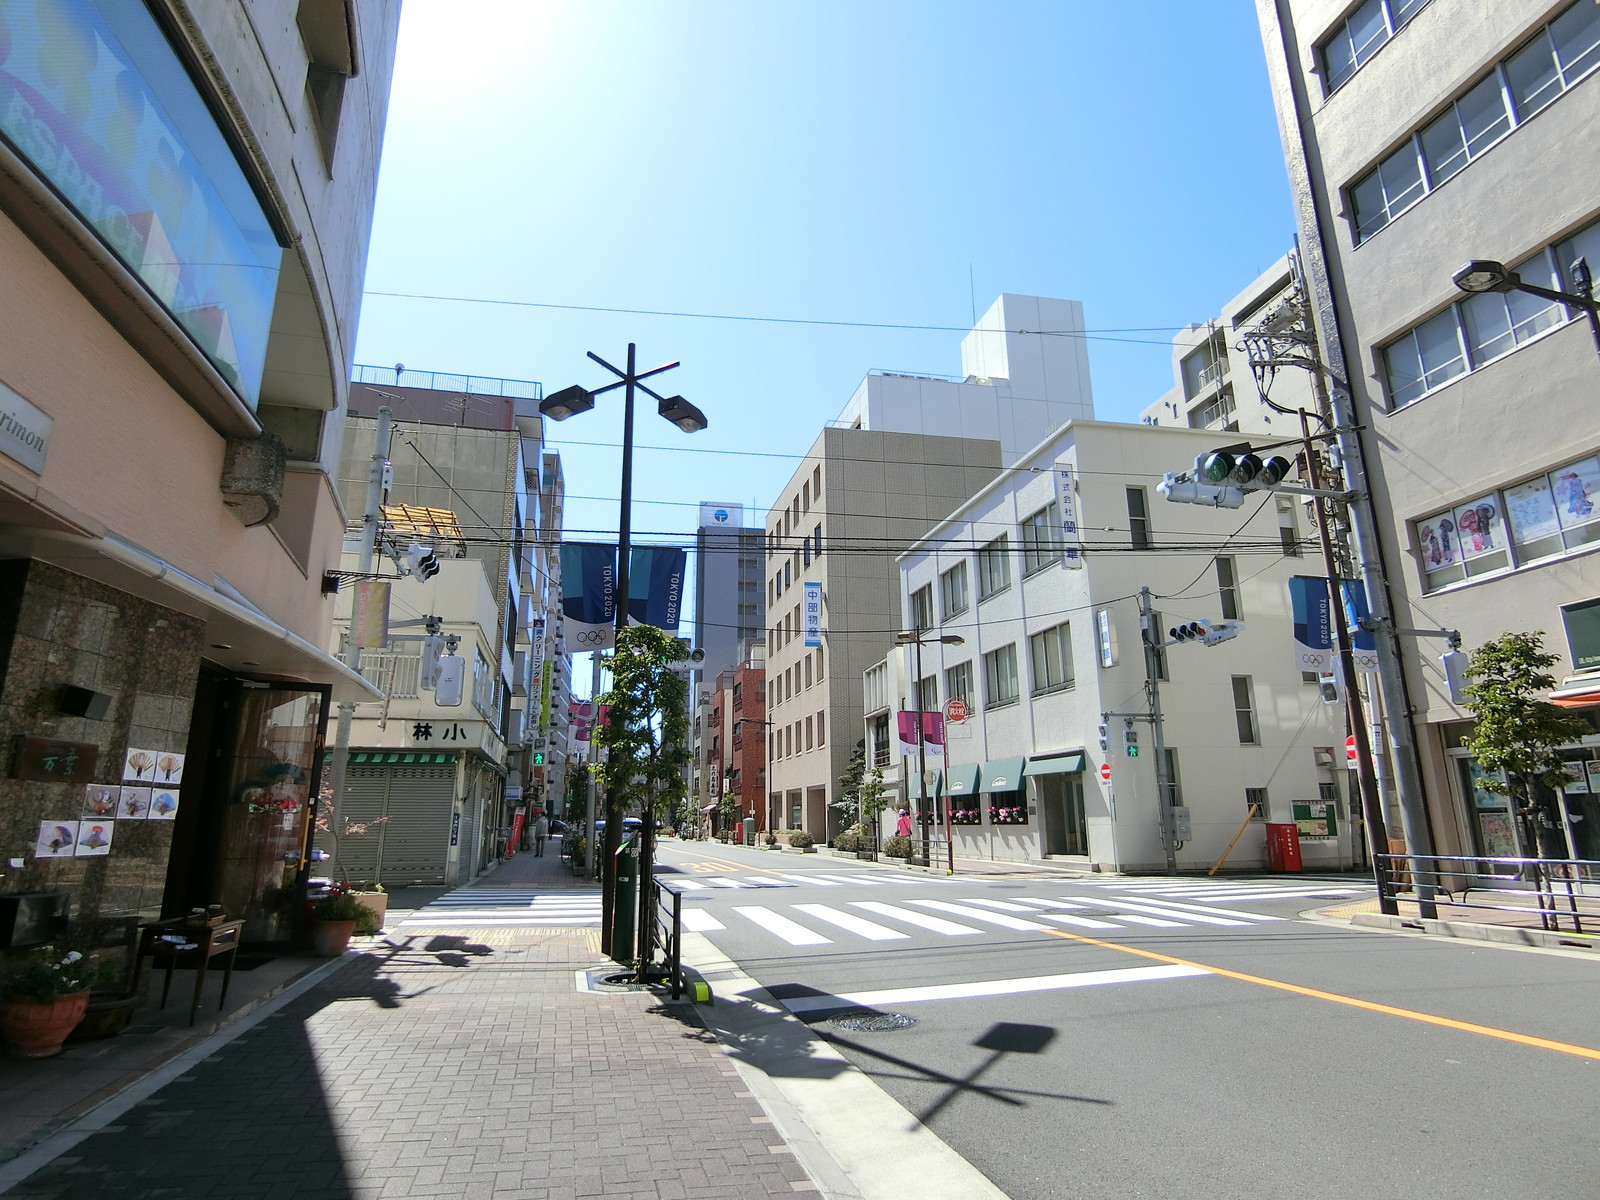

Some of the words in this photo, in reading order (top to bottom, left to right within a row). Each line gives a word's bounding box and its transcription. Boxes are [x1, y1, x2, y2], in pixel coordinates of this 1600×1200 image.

[0, 410, 45, 452] rimon
[603, 564, 613, 594] TOKYO
[669, 572, 680, 603] TOKYO
[604, 595, 613, 617] 2020
[666, 602, 677, 624] 2020
[807, 590, 818, 638] 中部物産
[1319, 599, 1328, 624] TOKYO
[1320, 625, 1329, 644] 2020
[533, 635, 543, 677] クリーニング
